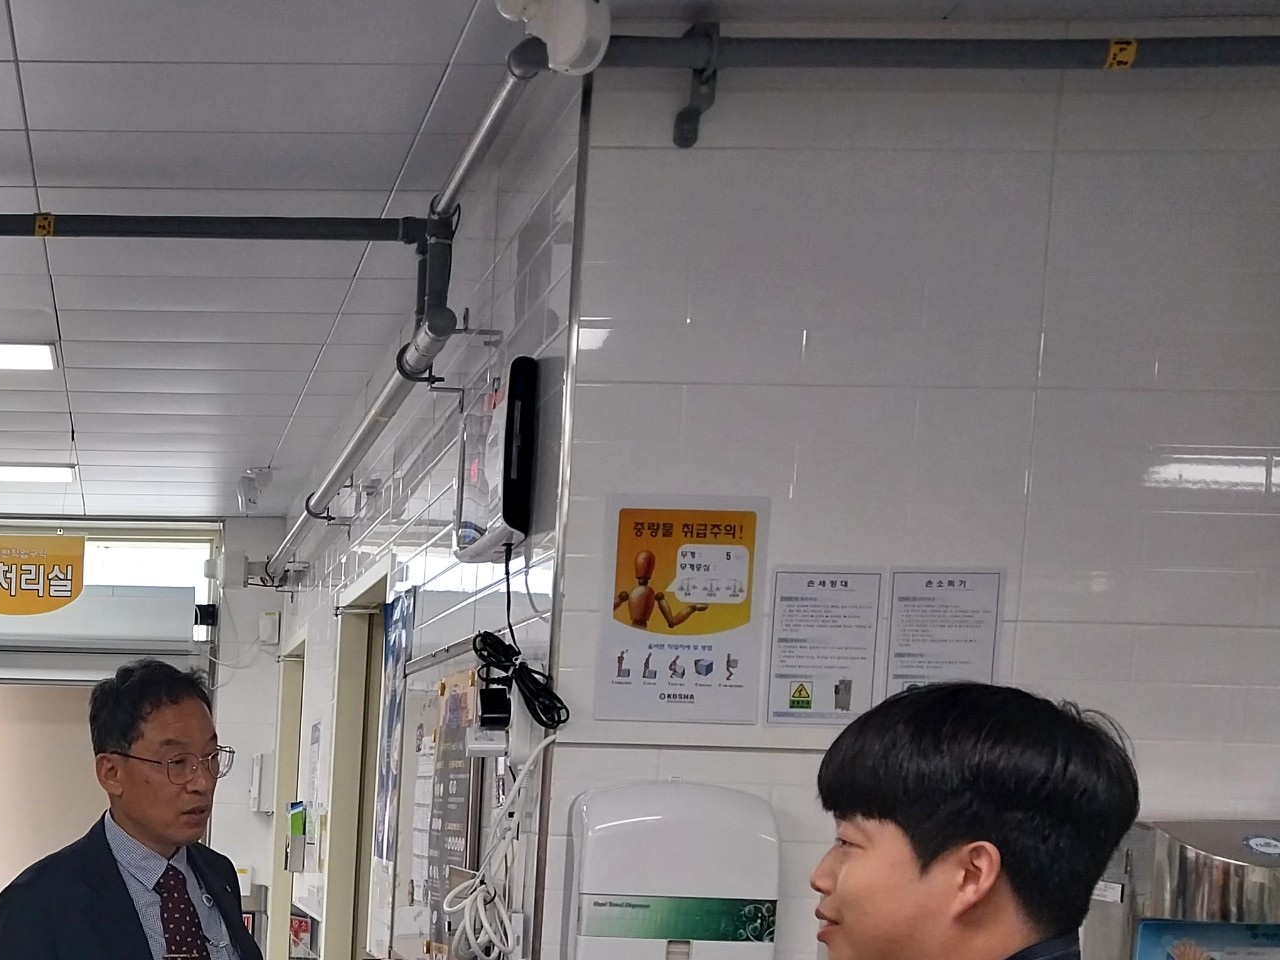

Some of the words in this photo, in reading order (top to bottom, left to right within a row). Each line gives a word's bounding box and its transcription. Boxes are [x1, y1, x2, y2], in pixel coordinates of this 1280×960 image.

[633, 522, 674, 538] 중량물
[681, 523, 743, 540] 취급주의!
[725, 552, 732, 560] 5
